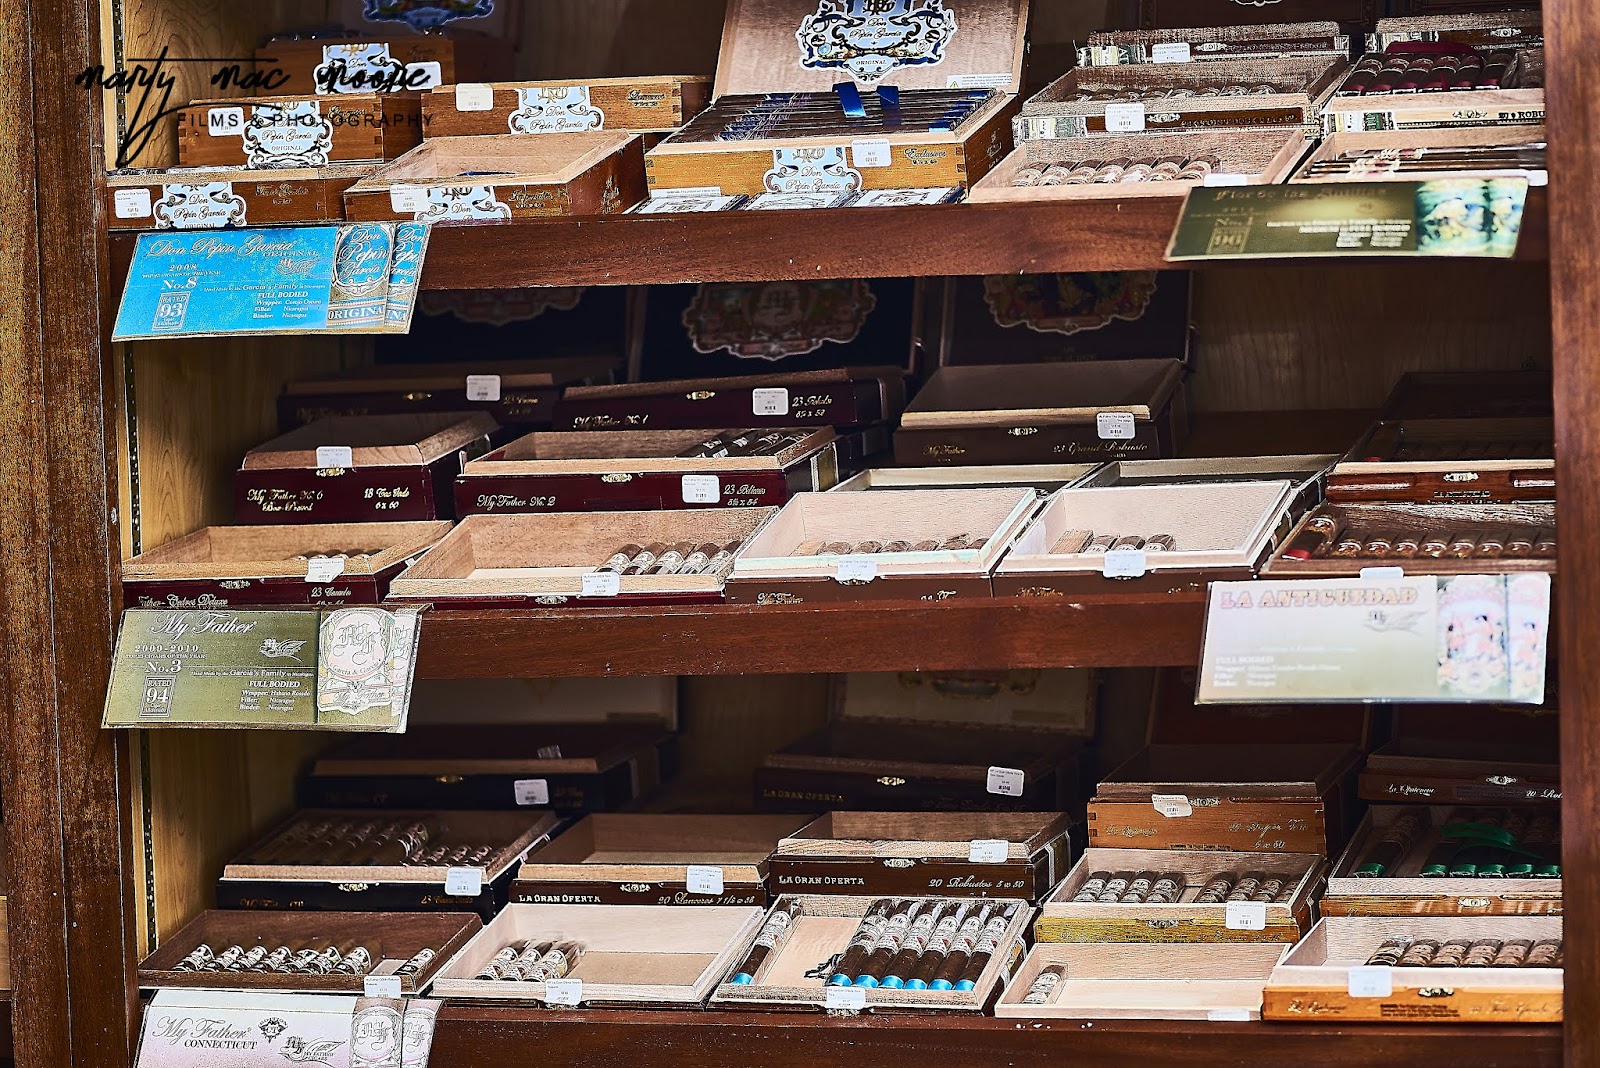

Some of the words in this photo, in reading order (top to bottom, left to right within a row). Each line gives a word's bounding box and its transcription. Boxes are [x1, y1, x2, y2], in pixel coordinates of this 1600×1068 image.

[867, 17, 887, 27] Don
[545, 106, 567, 118] Don
[801, 167, 822, 178] Don
[188, 194, 209, 205] Don
[451, 203, 472, 214] Don
[351, 228, 381, 241] Don
[148, 238, 187, 257] Don
[278, 290, 309, 299] BODIED
[160, 302, 183, 318] 93
[792, 396, 804, 408] 23
[1068, 442, 1100, 456] Grand
[723, 483, 736, 495] 23
[247, 489, 266, 505] My
[268, 489, 297, 501] Father
[316, 490, 324, 501] 6
[476, 494, 497, 511] My
[497, 495, 527, 508] Father
[545, 496, 557, 507] 2
[375, 501, 381, 510] 6
[388, 500, 400, 510] 60
[310, 587, 323, 598] 23
[1220, 590, 1254, 609] LA
[150, 611, 195, 642] My
[193, 612, 256, 635] Father
[134, 644, 200, 653] 2009-2010
[145, 659, 182, 674] No.3
[261, 669, 286, 678] Family
[147, 680, 172, 688] RATED
[146, 687, 169, 704] 94
[778, 874, 794, 885] LA
[794, 875, 822, 885] GRAN
[824, 875, 866, 886] OFERTA
[928, 878, 943, 888] 20
[946, 874, 993, 889] Robustos
[1012, 880, 1025, 889] 50
[518, 894, 533, 903] LA
[534, 894, 561, 903] GRAN
[562, 894, 602, 903] OFERTA
[151, 1015, 191, 1046] My
[189, 1017, 249, 1040] Father
[266, 1026, 279, 1034] CT
[183, 1039, 258, 1050] CONNECTICUT
